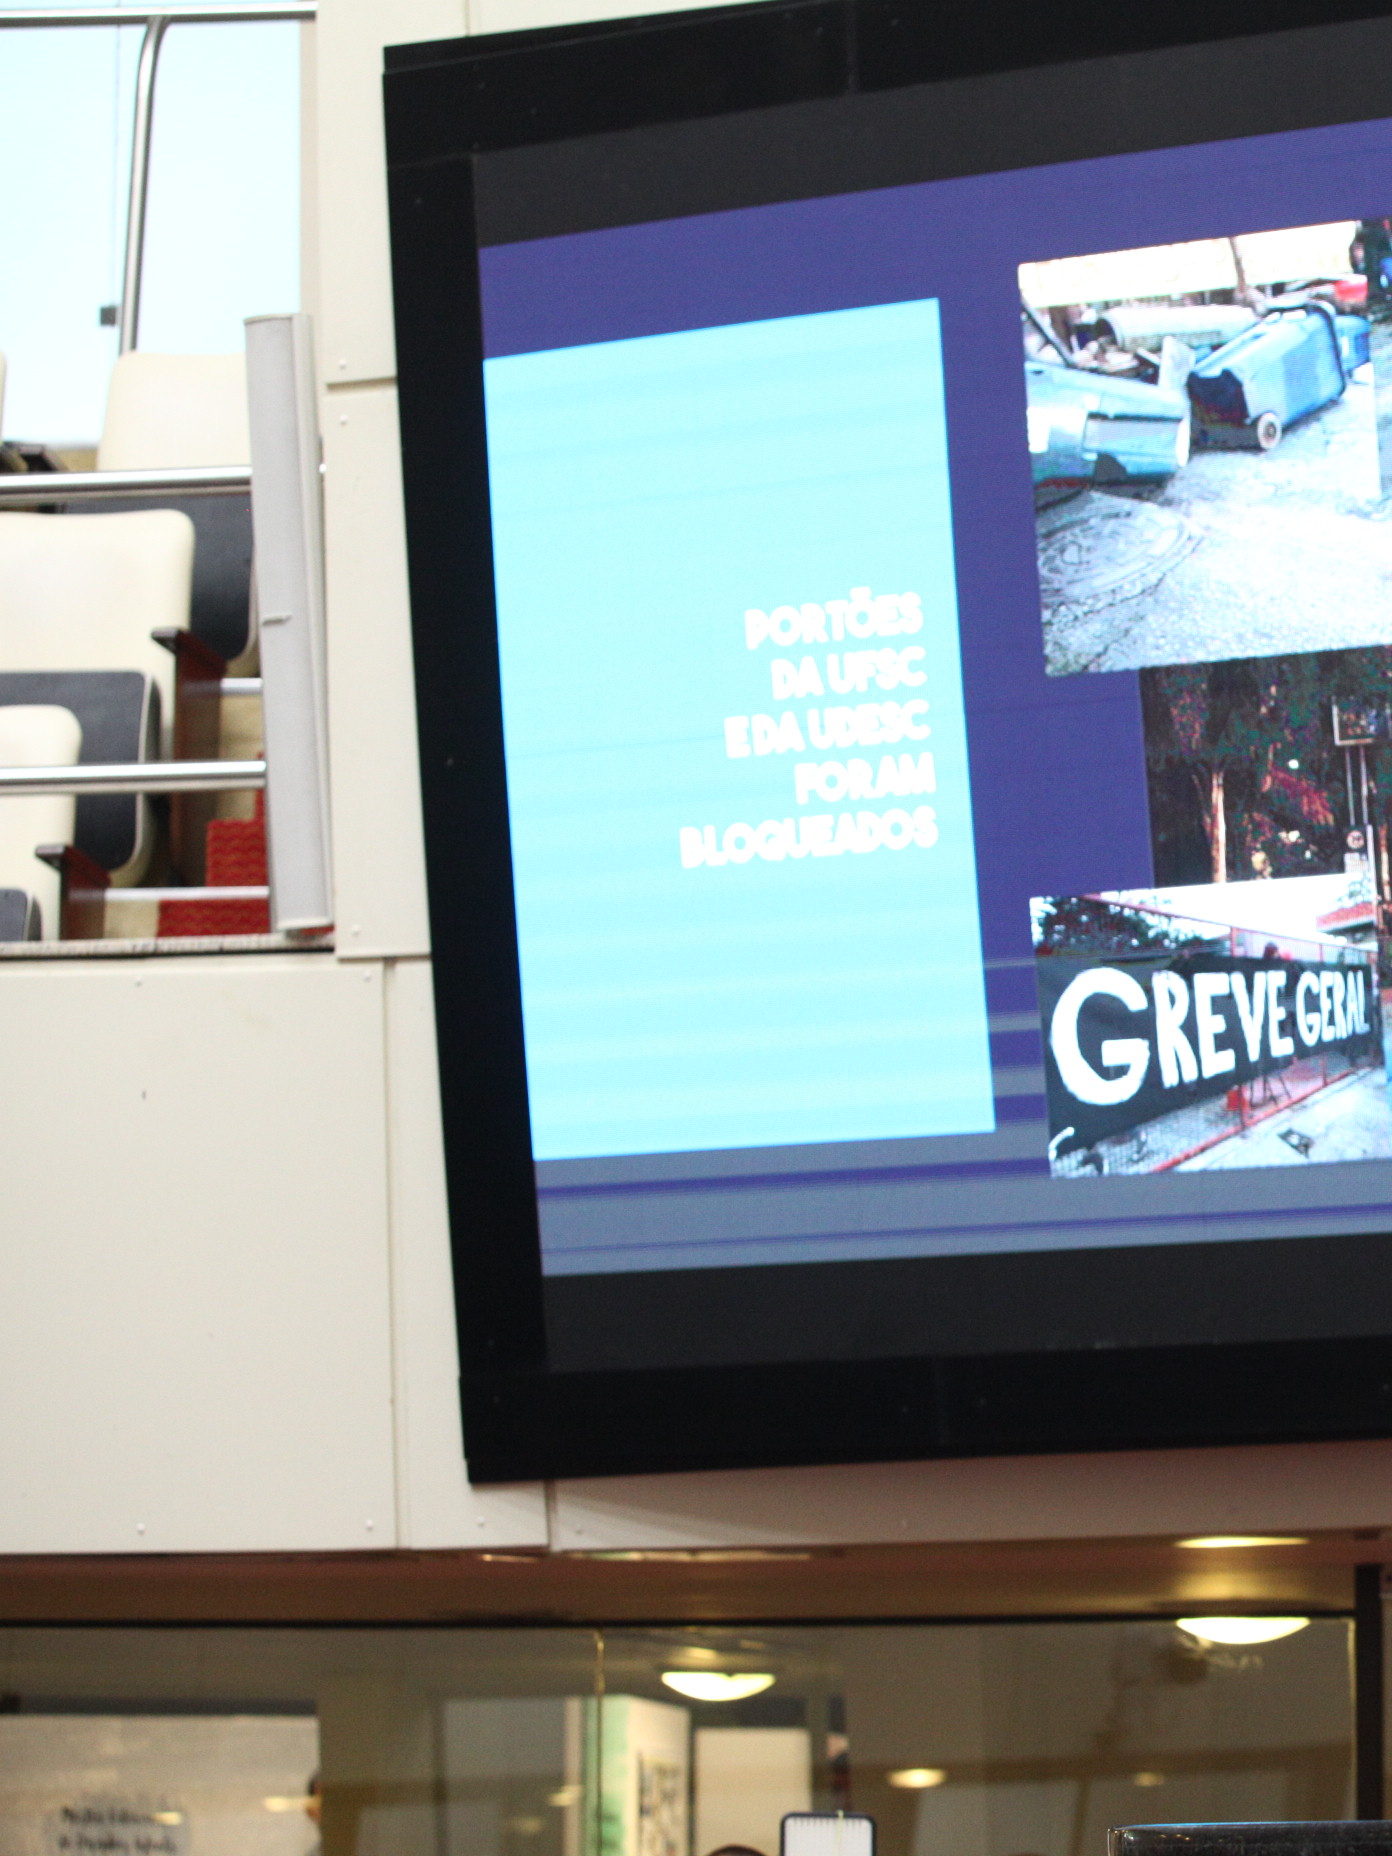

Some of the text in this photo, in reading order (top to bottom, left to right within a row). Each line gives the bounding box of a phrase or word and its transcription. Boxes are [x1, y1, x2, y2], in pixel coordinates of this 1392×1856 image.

[745, 586, 924, 650] PORTÕES
[770, 646, 928, 700] DA UFSC
[807, 699, 932, 749] UDESC
[794, 752, 937, 804] FORAM
[679, 805, 939, 869] BLOQUEADOS
[1051, 967, 1371, 1105] GREVE GERAL
